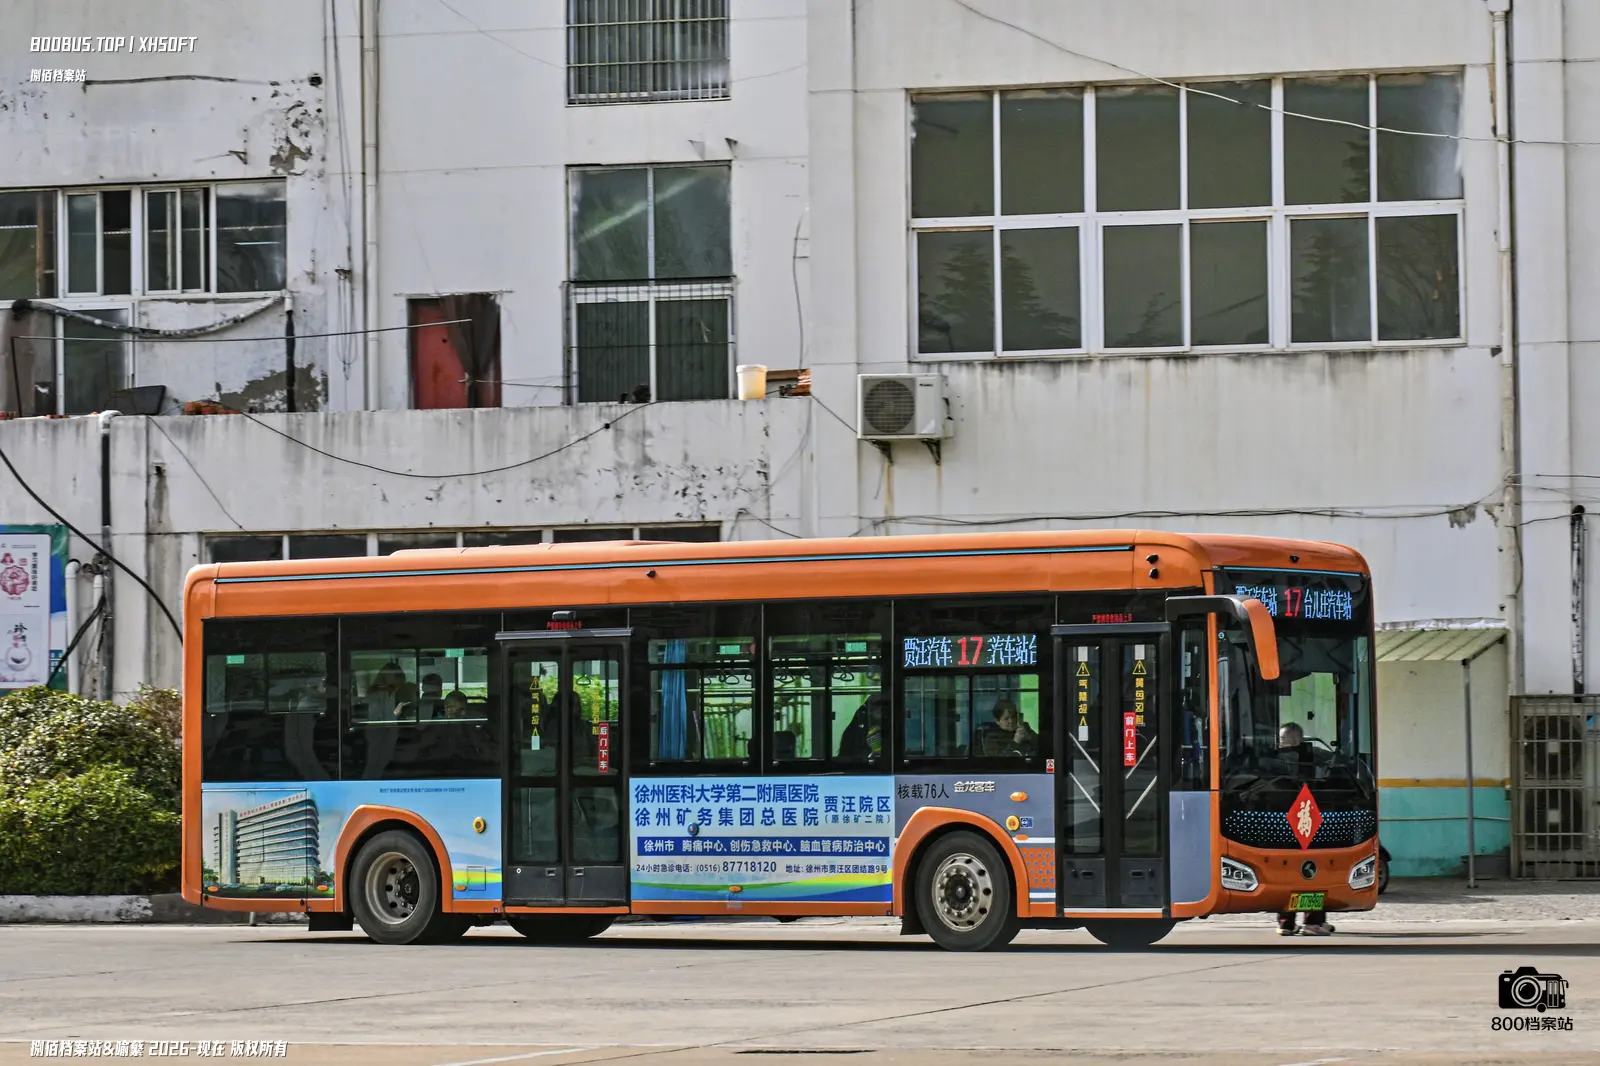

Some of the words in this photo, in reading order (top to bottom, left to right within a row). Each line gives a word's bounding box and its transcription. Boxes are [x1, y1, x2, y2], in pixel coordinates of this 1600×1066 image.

[1284, 588, 1302, 617] 17
[1304, 588, 1353, 620] 台儿庄汽车站
[903, 637, 953, 666] 贾汪汽车
[957, 636, 983, 665] 17
[599, 726, 608, 769] 后门下车
[1124, 715, 1135, 762] 前门上车
[634, 783, 819, 804] 徐州医科大学第二附属医院
[898, 783, 950, 799] 核载76人
[954, 781, 995, 793] 金龙客车
[824, 796, 891, 813] 贾汪院区
[634, 807, 819, 827] 徐州矿务集团总医院
[644, 840, 675, 853] 徐州市
